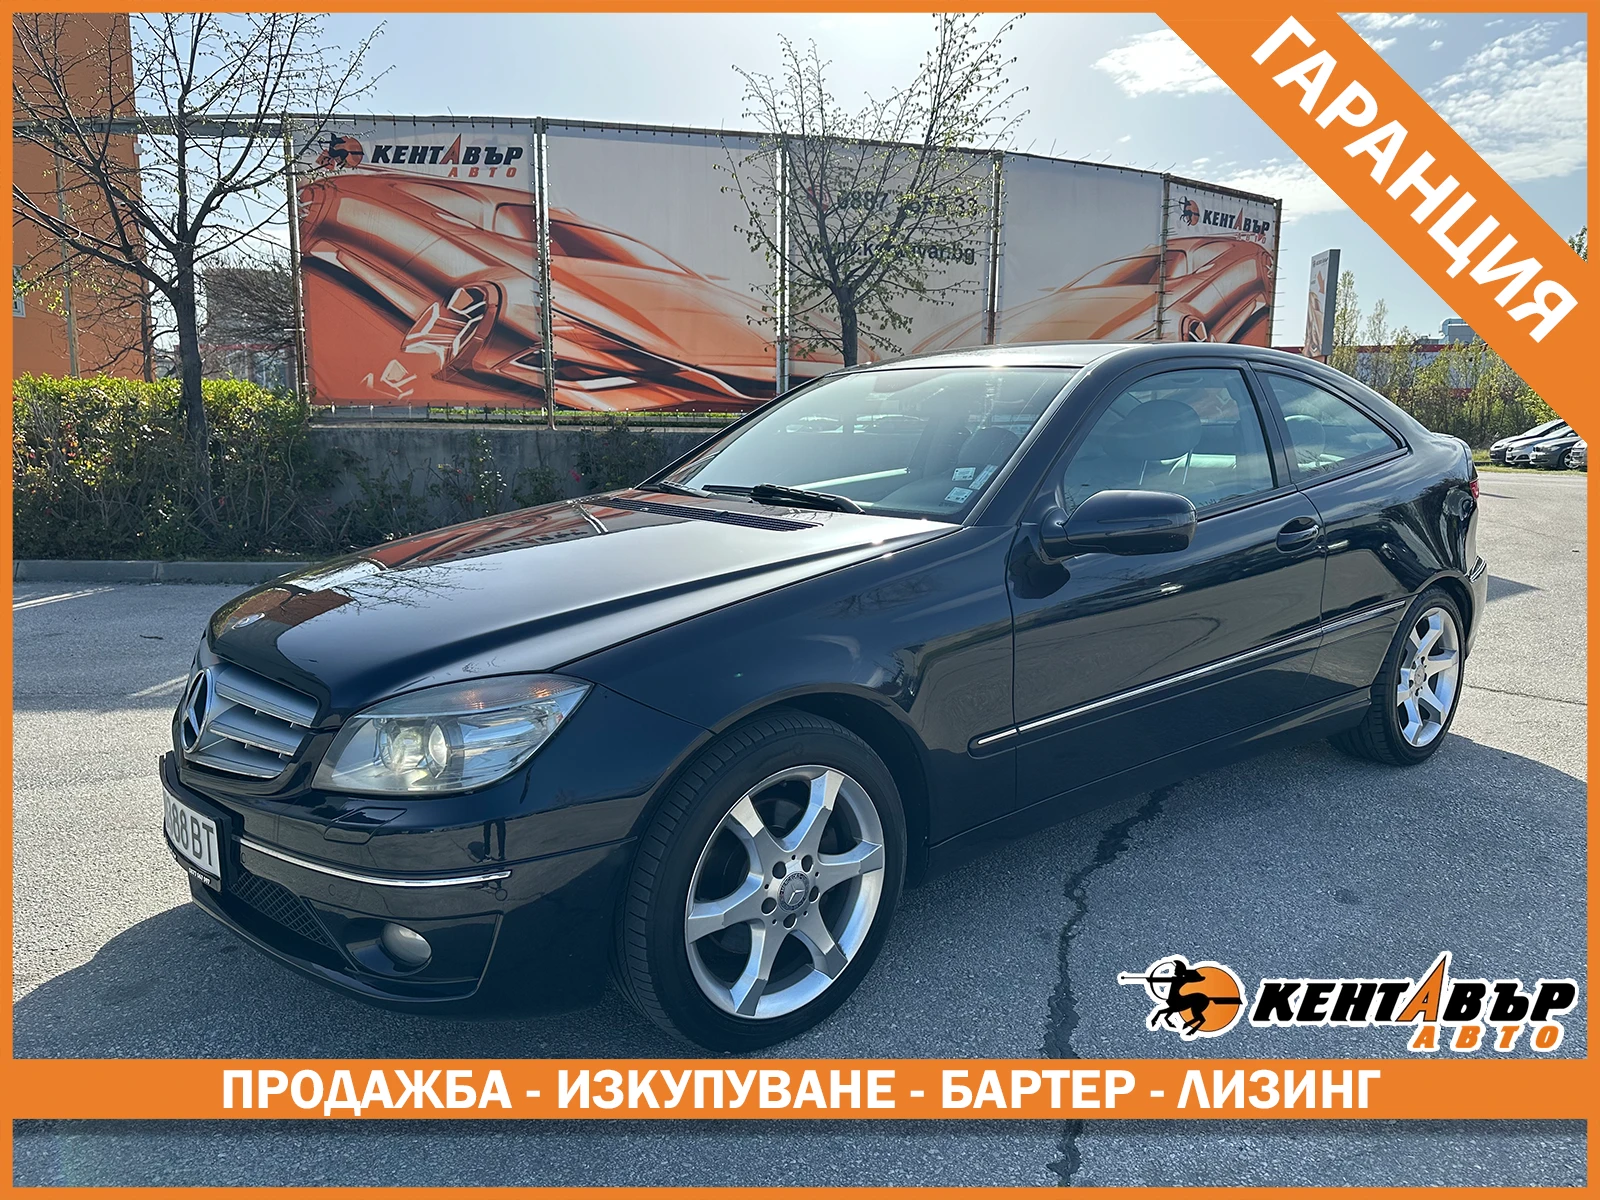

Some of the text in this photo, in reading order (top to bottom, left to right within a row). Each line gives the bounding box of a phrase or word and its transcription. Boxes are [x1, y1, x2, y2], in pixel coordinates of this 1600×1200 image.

[370, 133, 524, 166] КЕНТАВЪР
[447, 166, 518, 179] АВТО
[1202, 206, 1271, 234] КЕНТАВЪР
